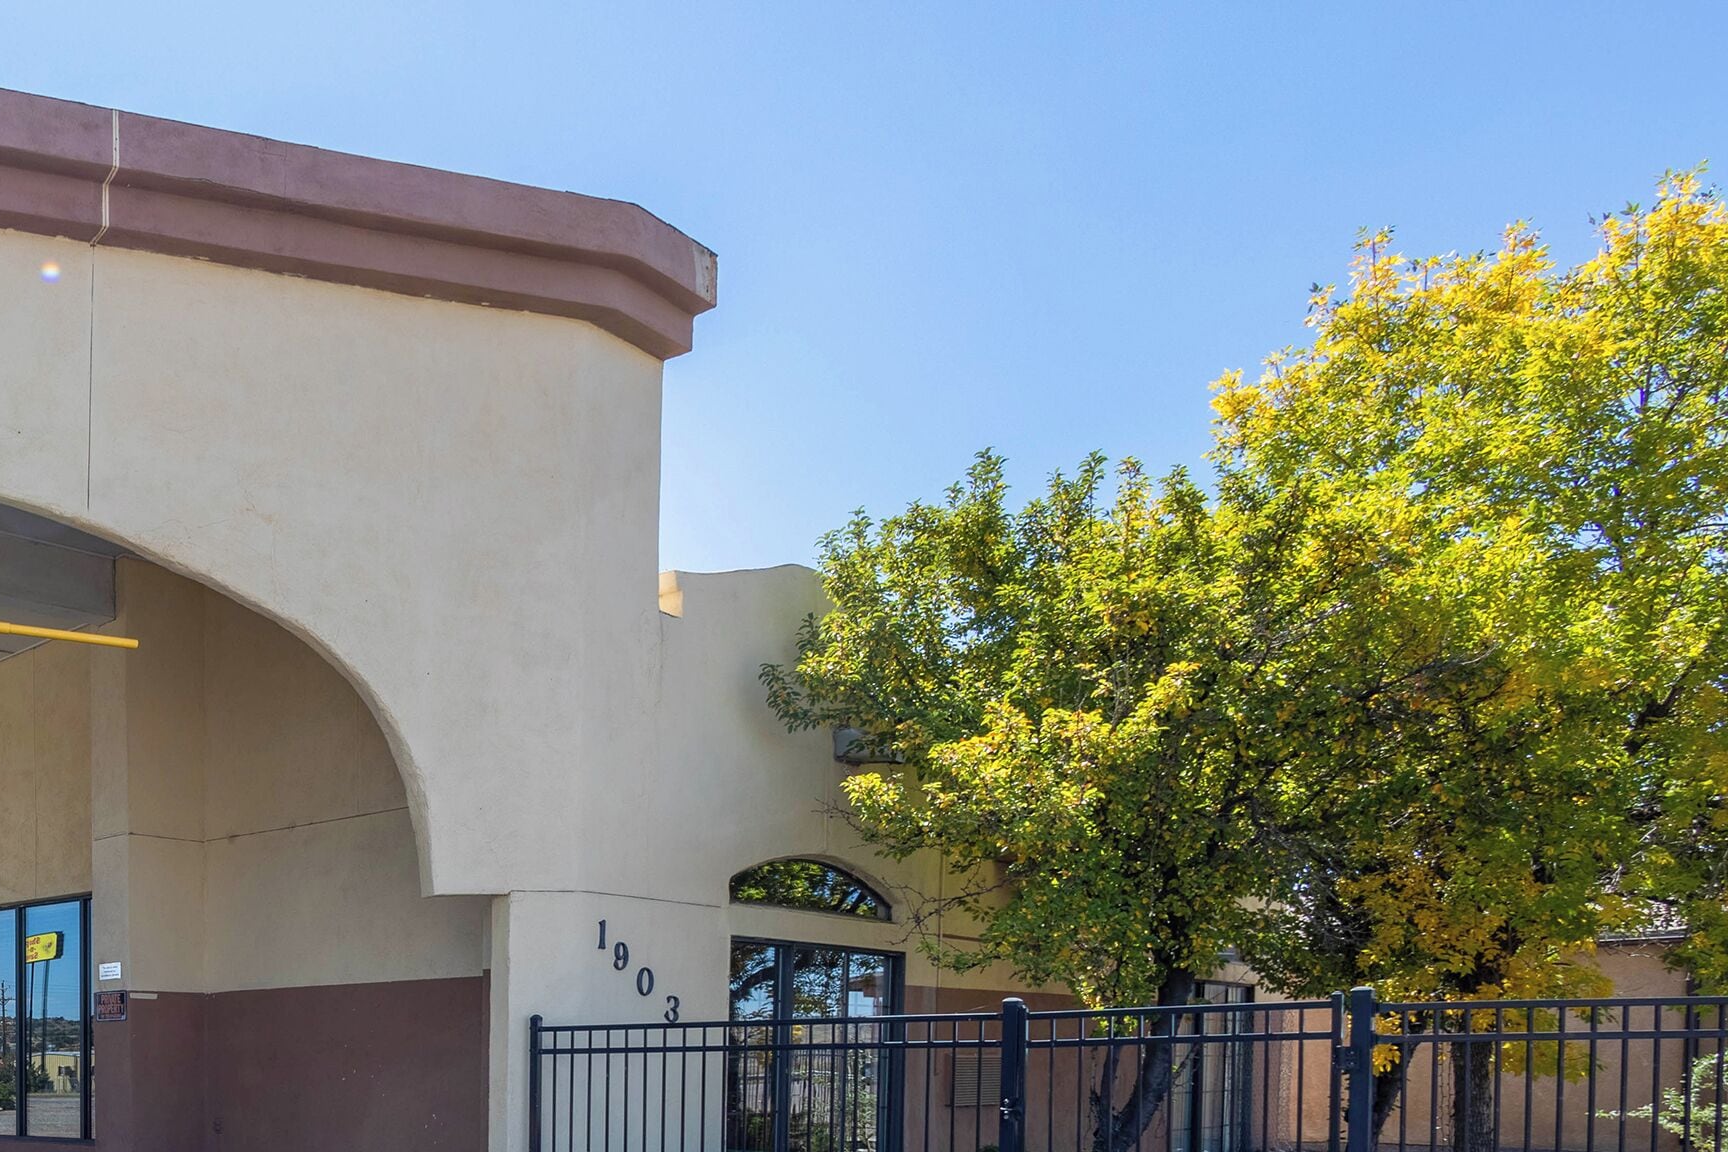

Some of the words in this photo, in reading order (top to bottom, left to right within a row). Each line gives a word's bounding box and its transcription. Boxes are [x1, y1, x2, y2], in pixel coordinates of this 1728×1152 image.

[598, 919, 680, 1023] 1903
[100, 993, 121, 1005] PRIVATE
[98, 1003, 124, 1014] PROPERTY
